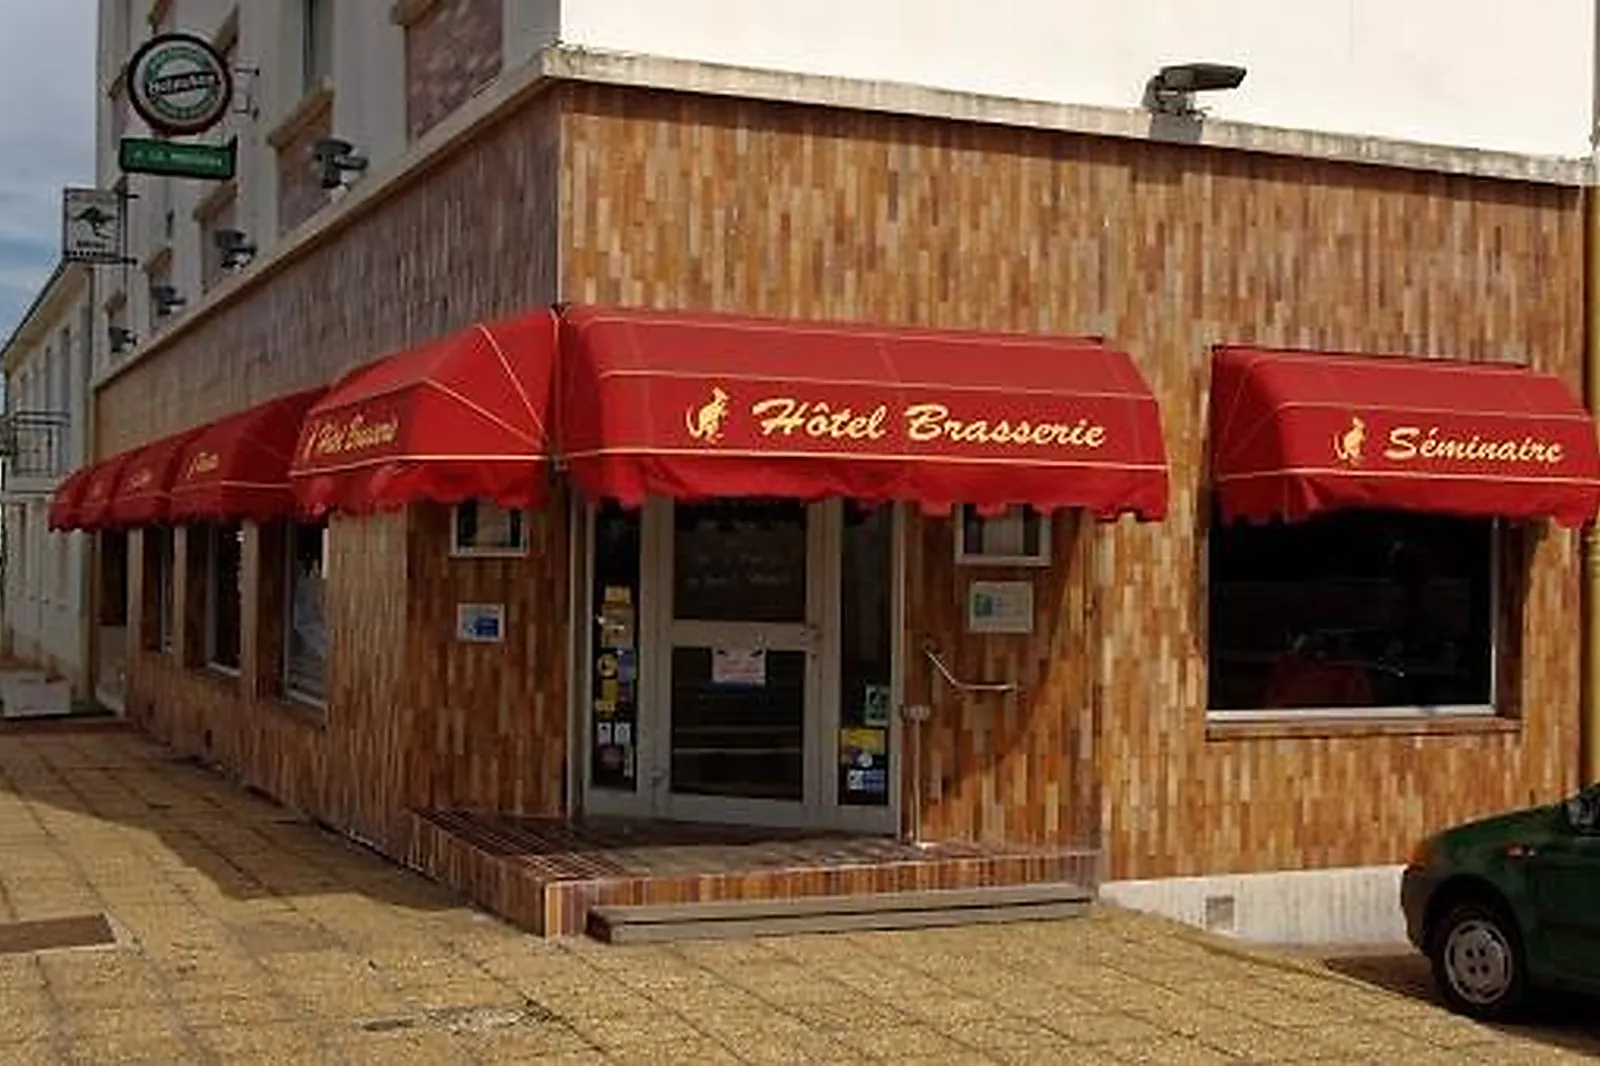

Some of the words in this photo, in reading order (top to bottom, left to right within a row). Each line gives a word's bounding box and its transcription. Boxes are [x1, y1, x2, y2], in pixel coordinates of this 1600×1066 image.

[752, 398, 887, 439] Hôtel
[904, 404, 1107, 447] Brasserie
[1385, 427, 1566, 462] Séminaire
